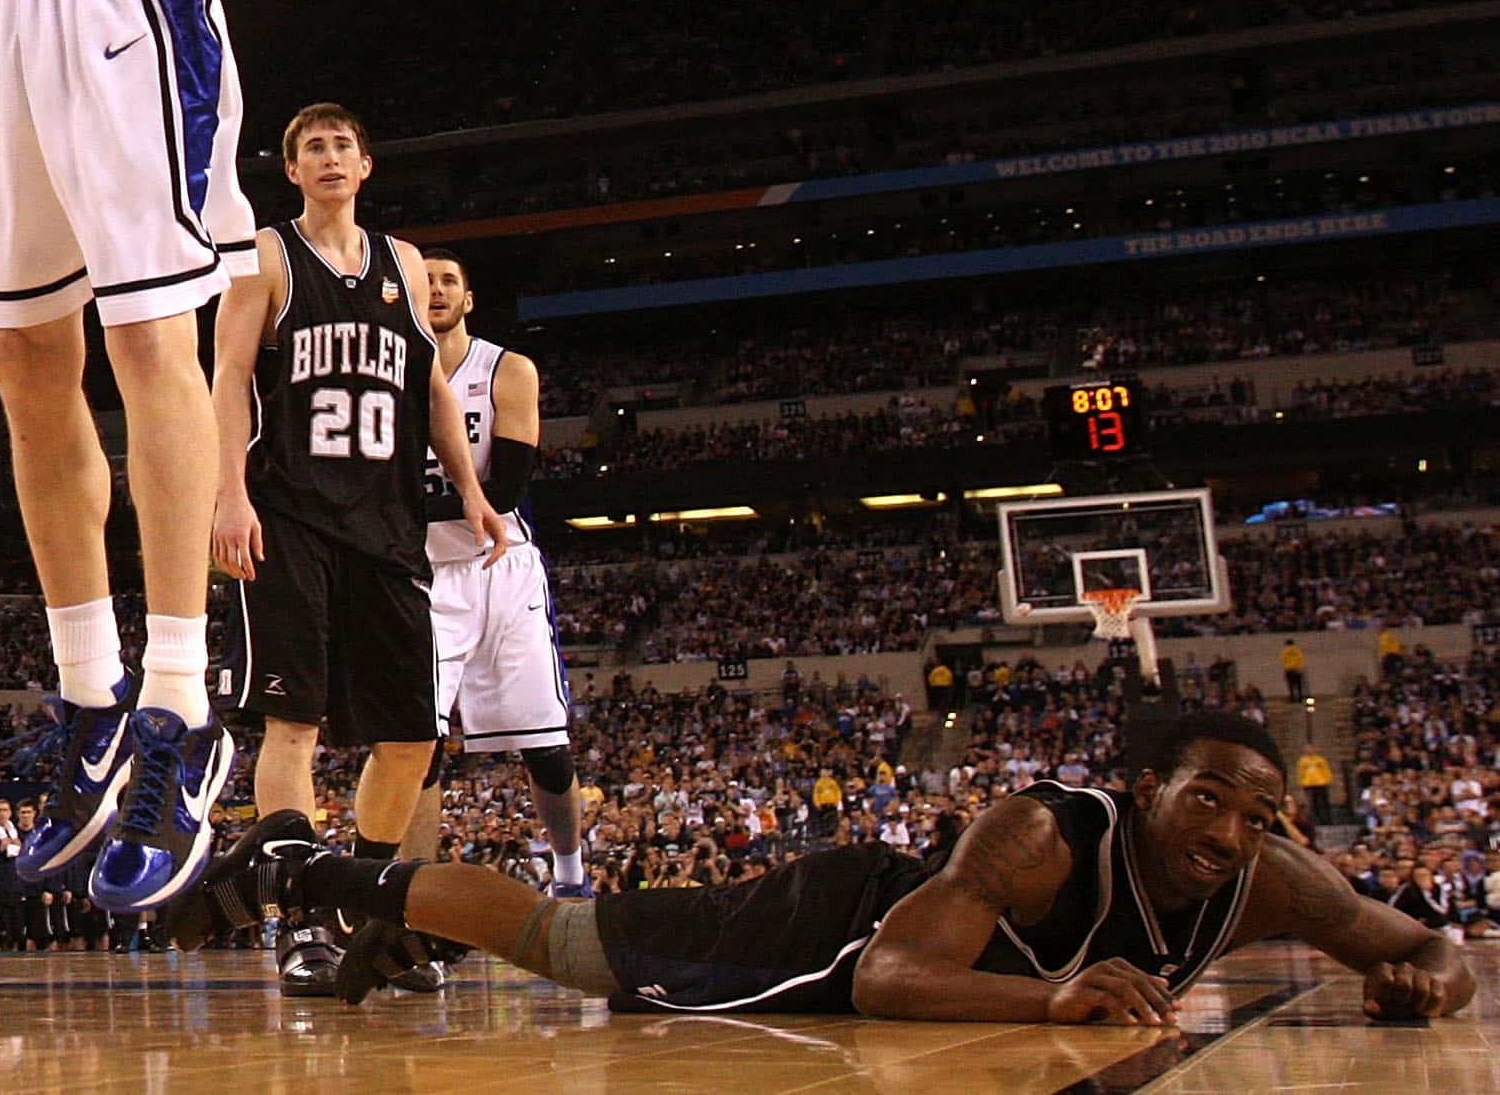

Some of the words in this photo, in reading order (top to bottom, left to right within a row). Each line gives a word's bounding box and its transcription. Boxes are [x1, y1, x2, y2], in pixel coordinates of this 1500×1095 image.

[995, 149, 1114, 178] WELCOME
[1119, 145, 1152, 164] TO
[1155, 139, 1204, 160] THE
[1208, 134, 1269, 155] 2010
[1272, 124, 1342, 148] NCAA
[1350, 116, 1430, 138] FINAL
[1124, 236, 1173, 255] THE
[1179, 226, 1247, 251] ROAD
[1249, 220, 1315, 243] ENDS
[290, 321, 408, 392] BUTLER
[1071, 386, 1130, 414] 8:07
[308, 386, 396, 462] 20
[1087, 411, 1126, 452] 13
[720, 664, 746, 677] 125
